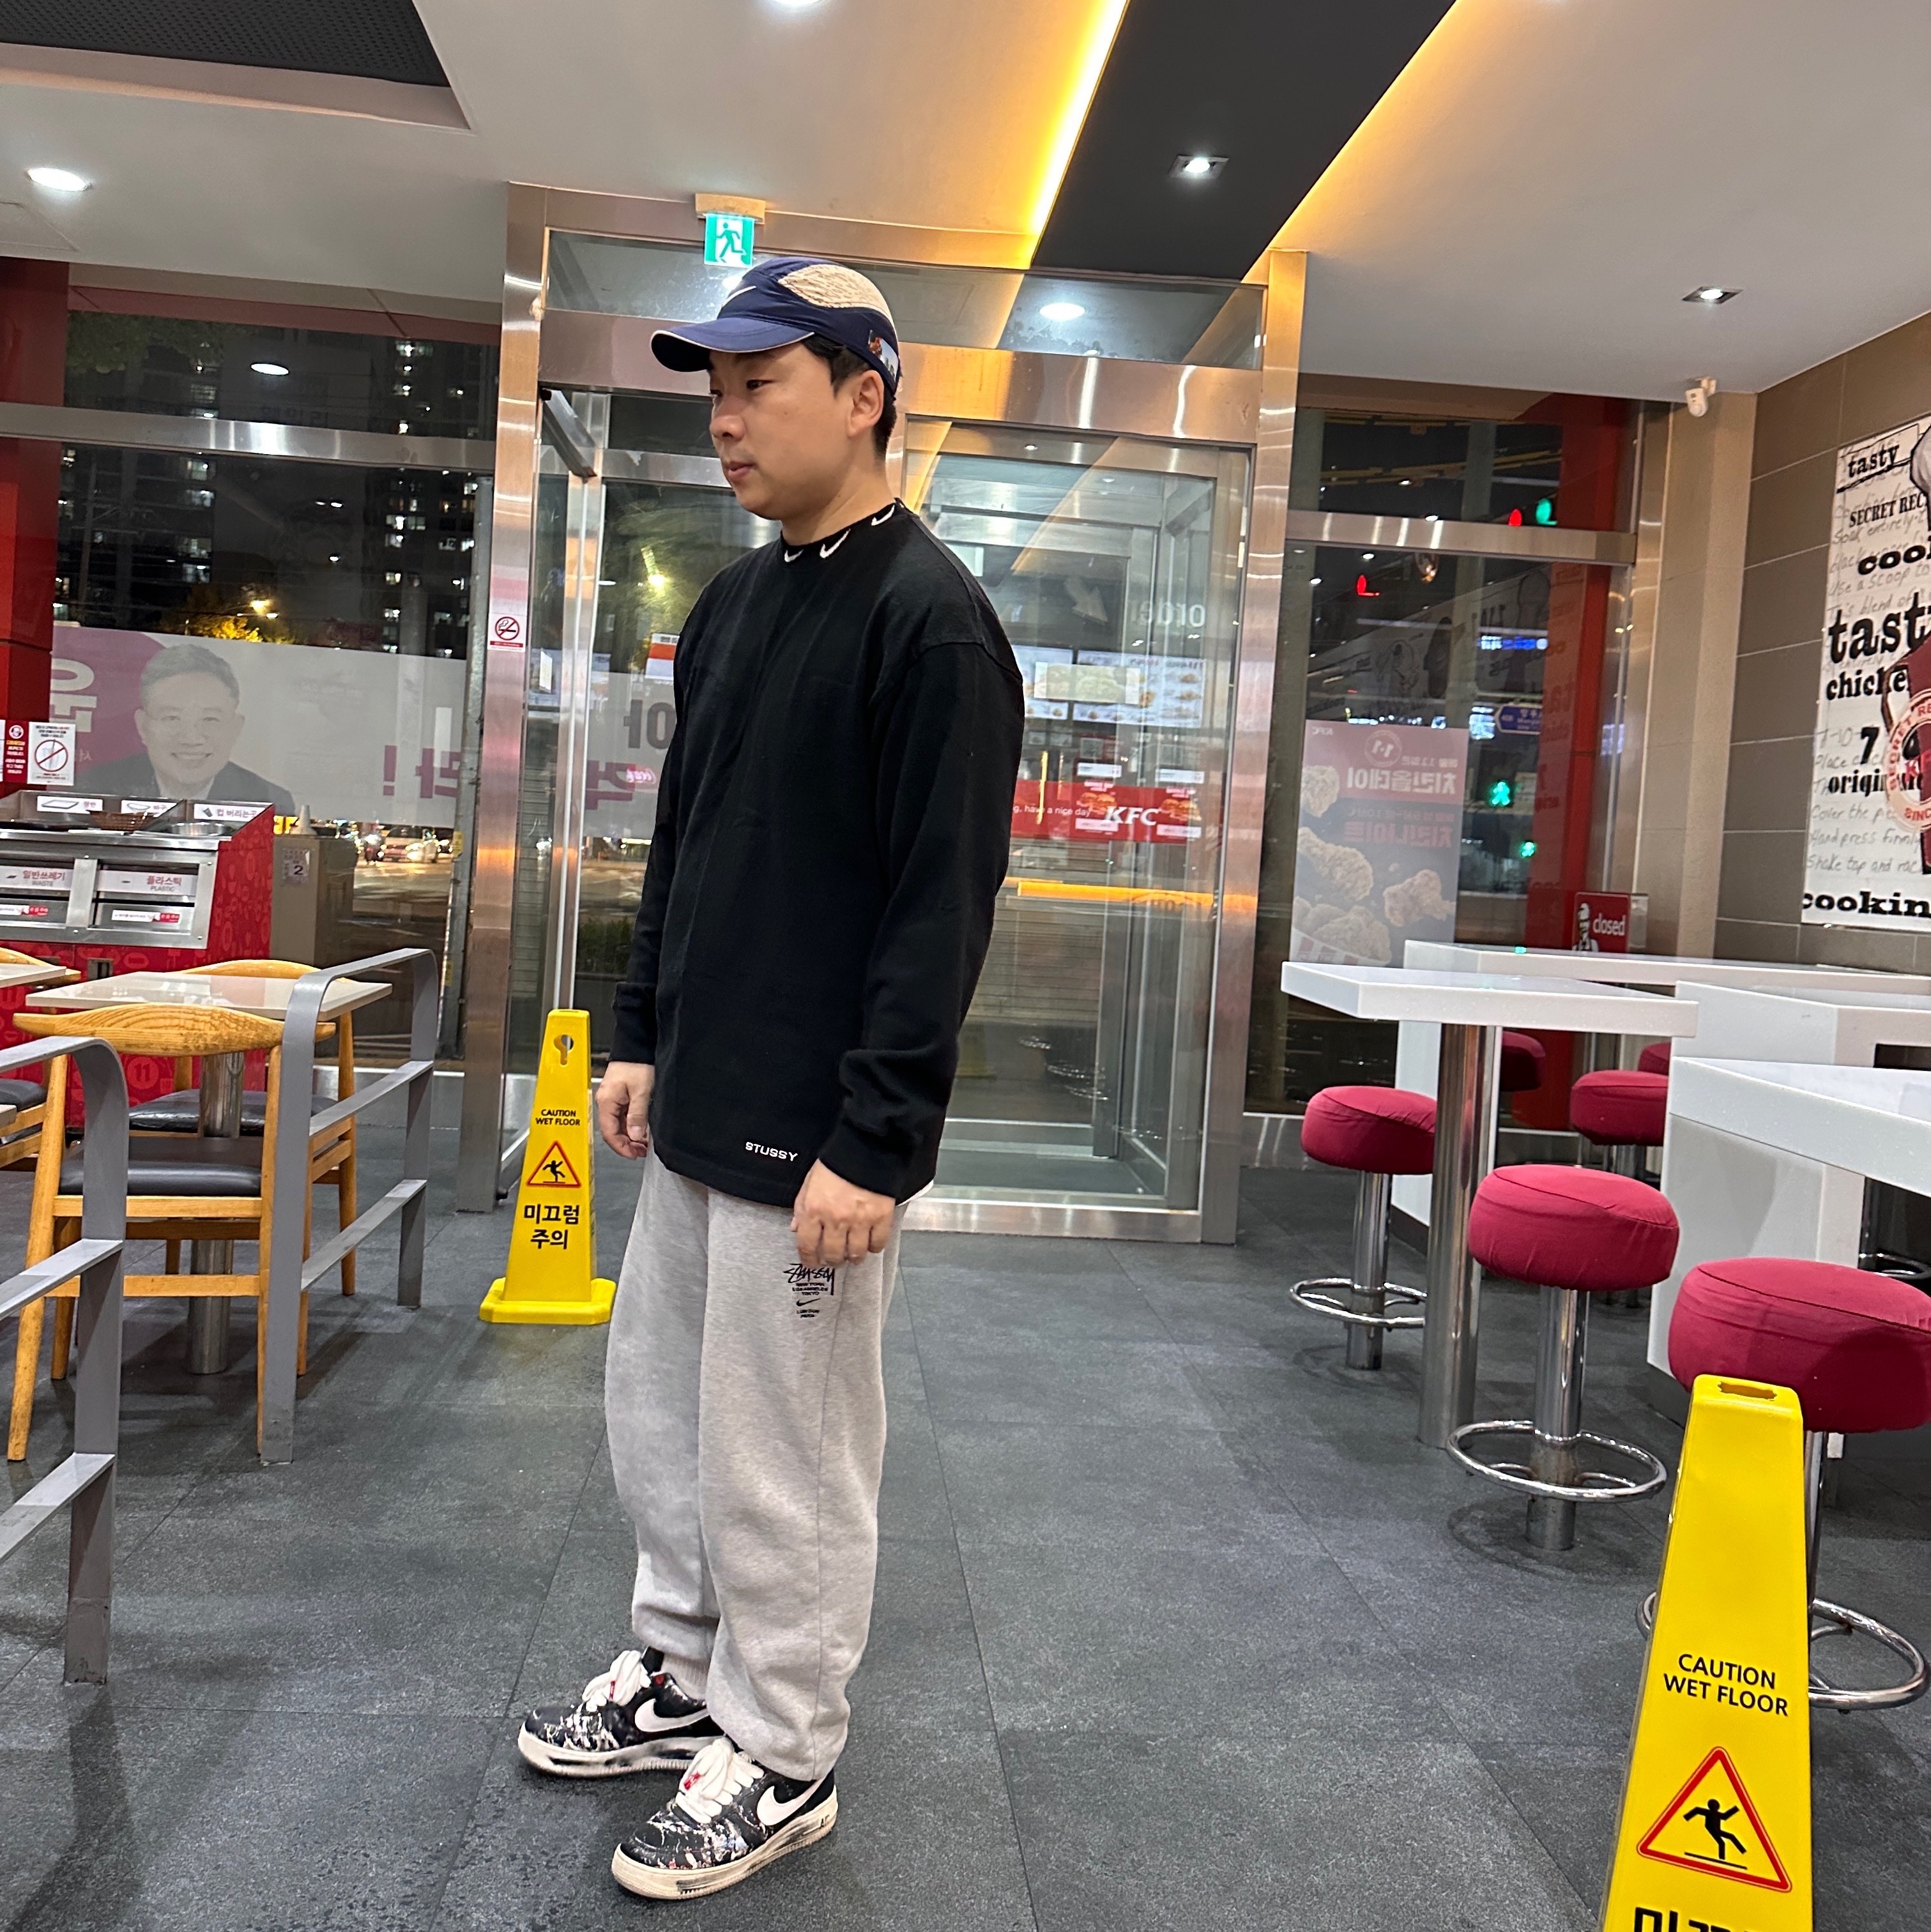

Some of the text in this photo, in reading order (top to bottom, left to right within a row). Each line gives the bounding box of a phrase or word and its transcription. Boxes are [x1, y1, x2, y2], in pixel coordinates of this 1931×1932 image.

[1848, 444, 1899, 478] tasty
[1849, 492, 1928, 528] SECRET REC
[1858, 535, 1930, 575] coo
[1828, 591, 1931, 664] tast
[1826, 667, 1910, 701] chicke
[1861, 726, 1880, 766] 7
[1075, 807, 1091, 818] day
[1104, 806, 1161, 826] KFC
[146, 875, 183, 886] 플라스틱
[294, 865, 303, 876] 2
[1592, 912, 1626, 936] closed
[541, 1109, 577, 1118] CAUTION
[745, 1141, 798, 1162] STUSSY
[524, 1203, 580, 1225] 미끄럼
[530, 1229, 569, 1250] 주의
[1678, 1653, 1776, 1690] CAUTION
[1663, 1673, 1789, 1717] WET FLOOR
